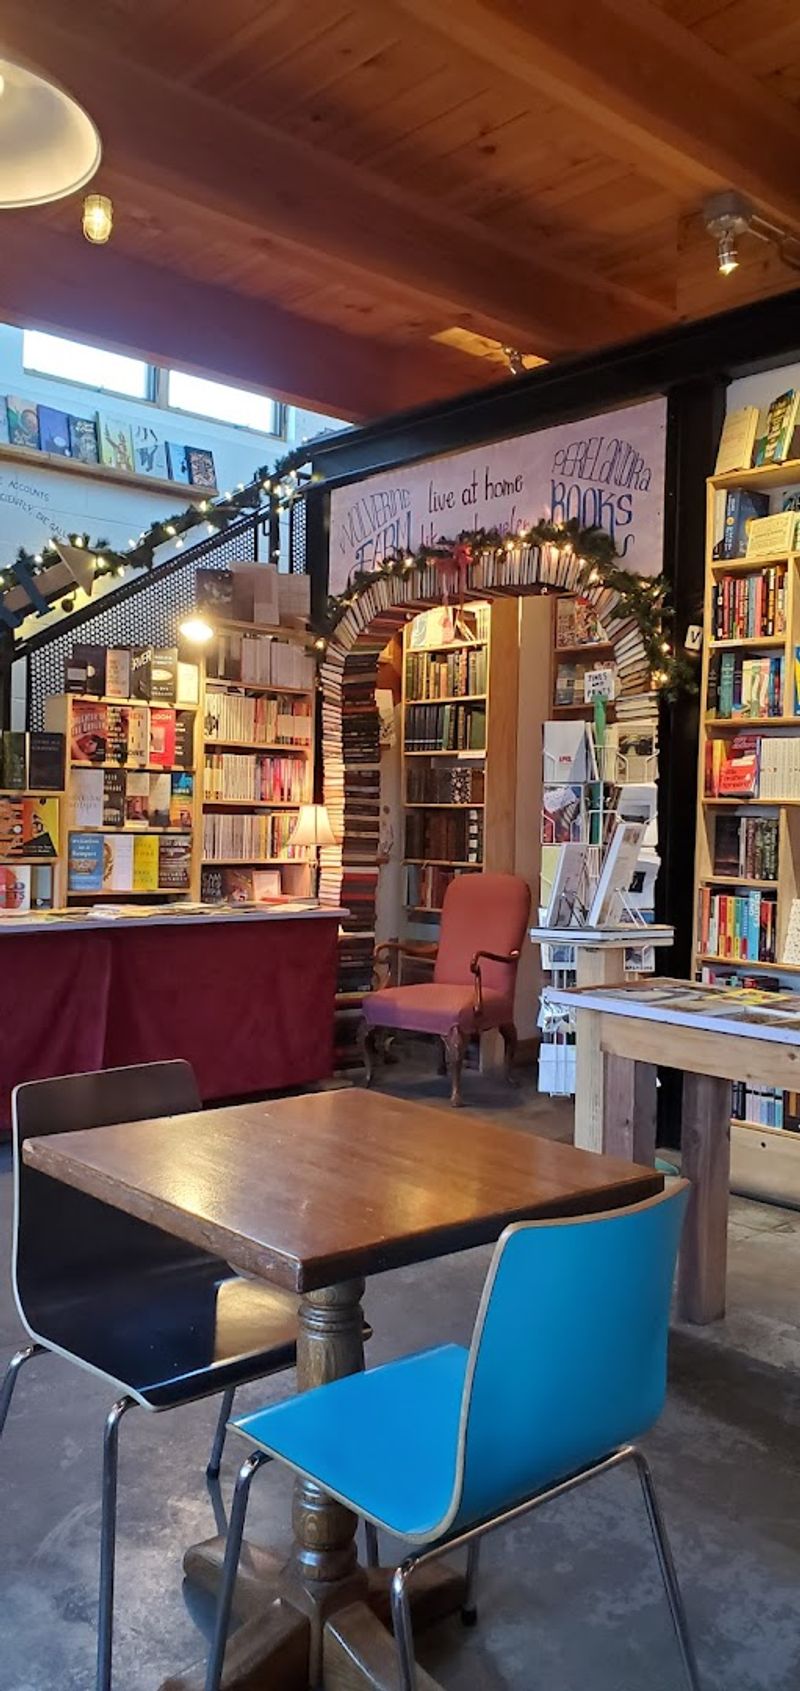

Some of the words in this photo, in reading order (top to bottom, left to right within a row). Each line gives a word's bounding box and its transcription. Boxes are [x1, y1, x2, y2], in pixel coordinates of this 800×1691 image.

[8, 480, 49, 502] ACCOUNTS
[428, 480, 456, 513] live
[461, 469, 478, 505] at
[485, 466, 524, 500] home
[551, 480, 635, 545] BOOKS
[340, 488, 411, 553] WOLVERINE
[349, 511, 412, 570] FARM
[420, 522, 439, 546] lik
